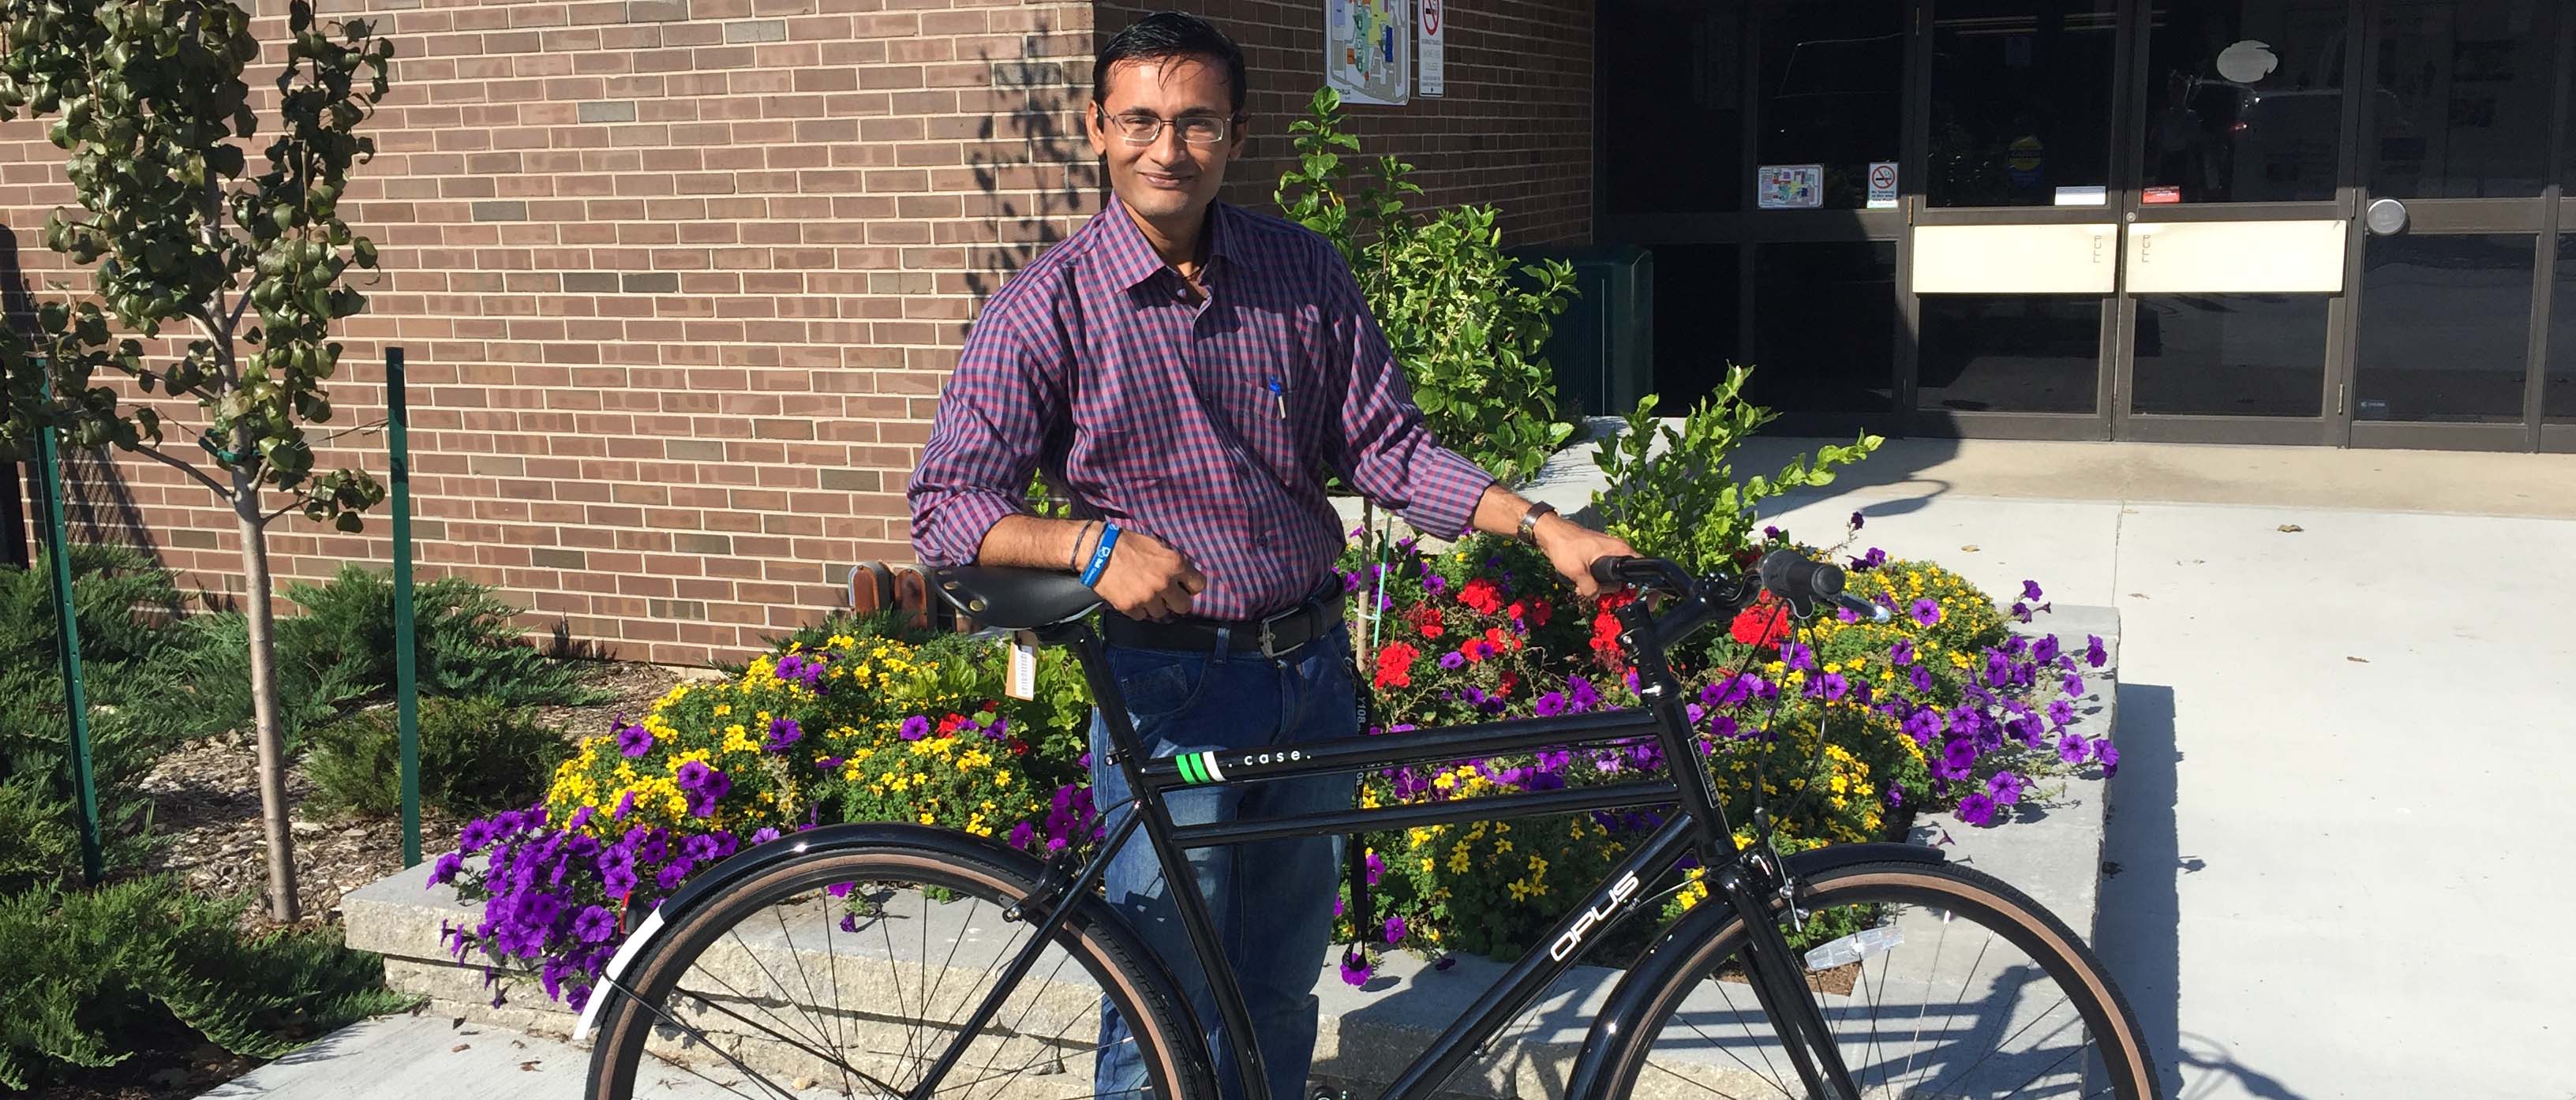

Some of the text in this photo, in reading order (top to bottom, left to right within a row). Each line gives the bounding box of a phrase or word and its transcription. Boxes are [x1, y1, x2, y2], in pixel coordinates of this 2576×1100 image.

[2093, 235, 2102, 264] PULL
[2142, 234, 2151, 263] PULL
[1550, 870, 1639, 962] OPUS
